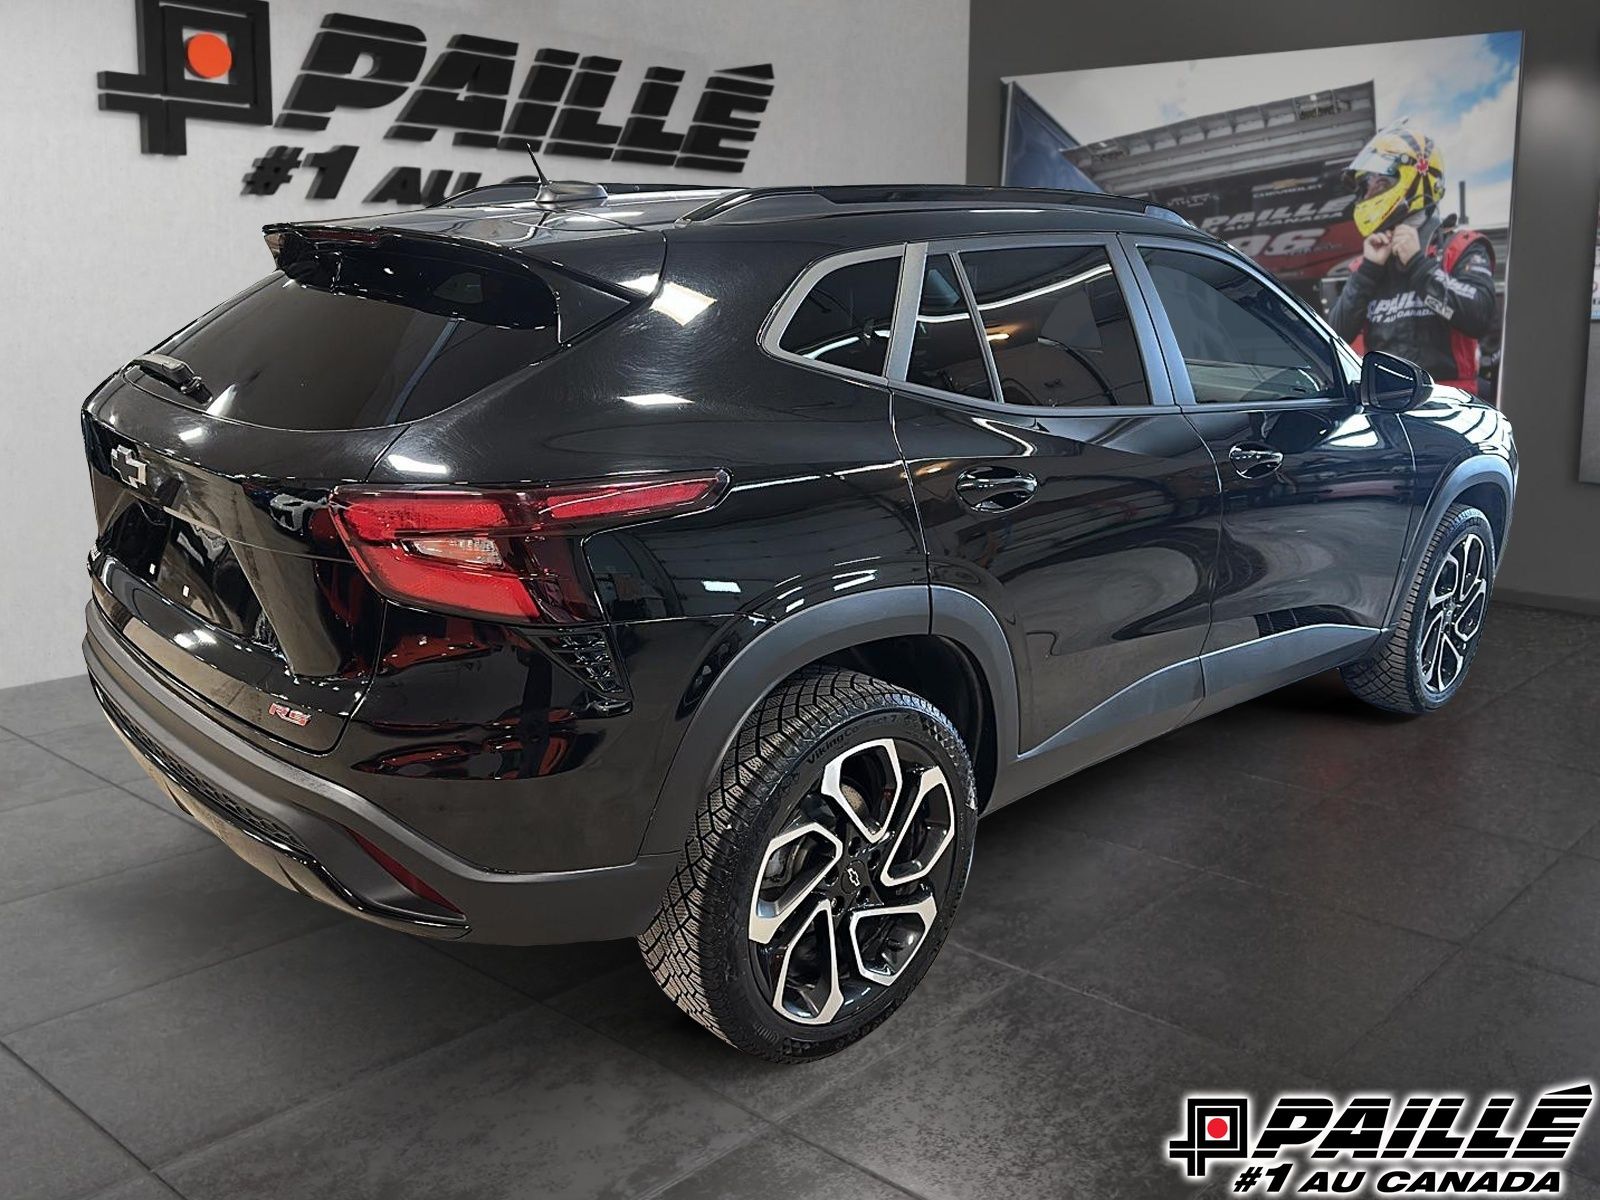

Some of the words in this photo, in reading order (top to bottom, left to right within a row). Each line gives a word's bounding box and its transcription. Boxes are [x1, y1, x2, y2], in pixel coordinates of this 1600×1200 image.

[273, 12, 774, 173] PAILLÉ
[240, 145, 360, 199] #1
[1252, 184, 1322, 198] CHEVROLET
[1256, 211, 1343, 228] CANADA
[269, 703, 311, 726] RS
